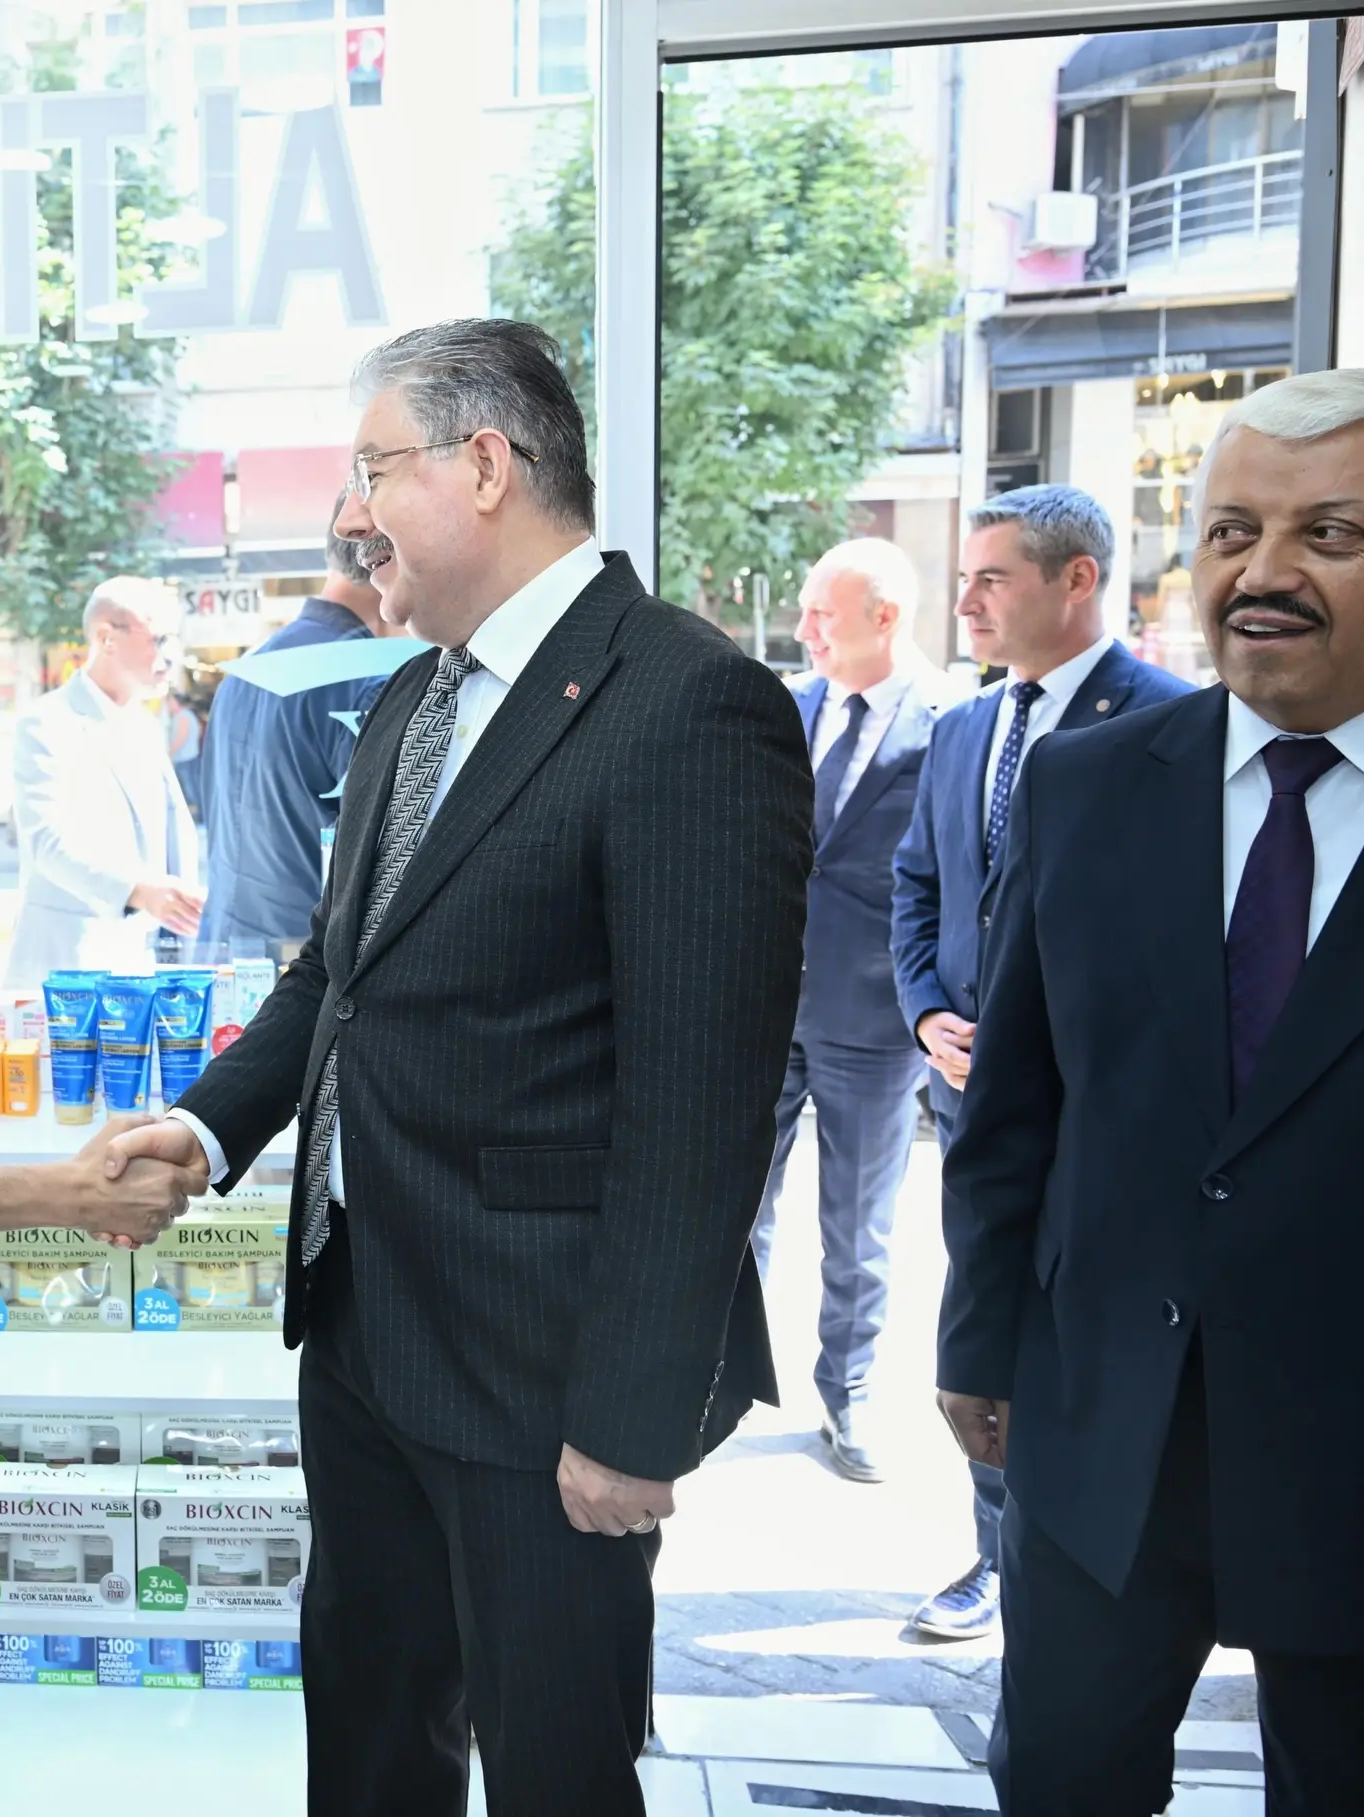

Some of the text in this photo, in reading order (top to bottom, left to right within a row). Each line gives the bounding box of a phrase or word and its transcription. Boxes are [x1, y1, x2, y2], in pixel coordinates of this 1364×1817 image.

[186, 589, 261, 616] SAYGI
[5, 1227, 85, 1244] BIOXCIN
[178, 1227, 259, 1245] BIOXCIN
[144, 1297, 169, 1310] 3 AL
[186, 1502, 309, 1520] BIOXCIN KLAS
[107, 1579, 124, 1589] ÖZEL
[149, 1576, 176, 1589] 3 AL
[21, 1593, 37, 1602] ÇOK
[38, 1593, 63, 1602] SATAN
[227, 1598, 252, 1606] SATAN
[38, 1672, 95, 1684] SPECIAL PRICE
[143, 1675, 174, 1686] SPECIAL
[249, 1678, 303, 1689] SPECIAL PRIC
